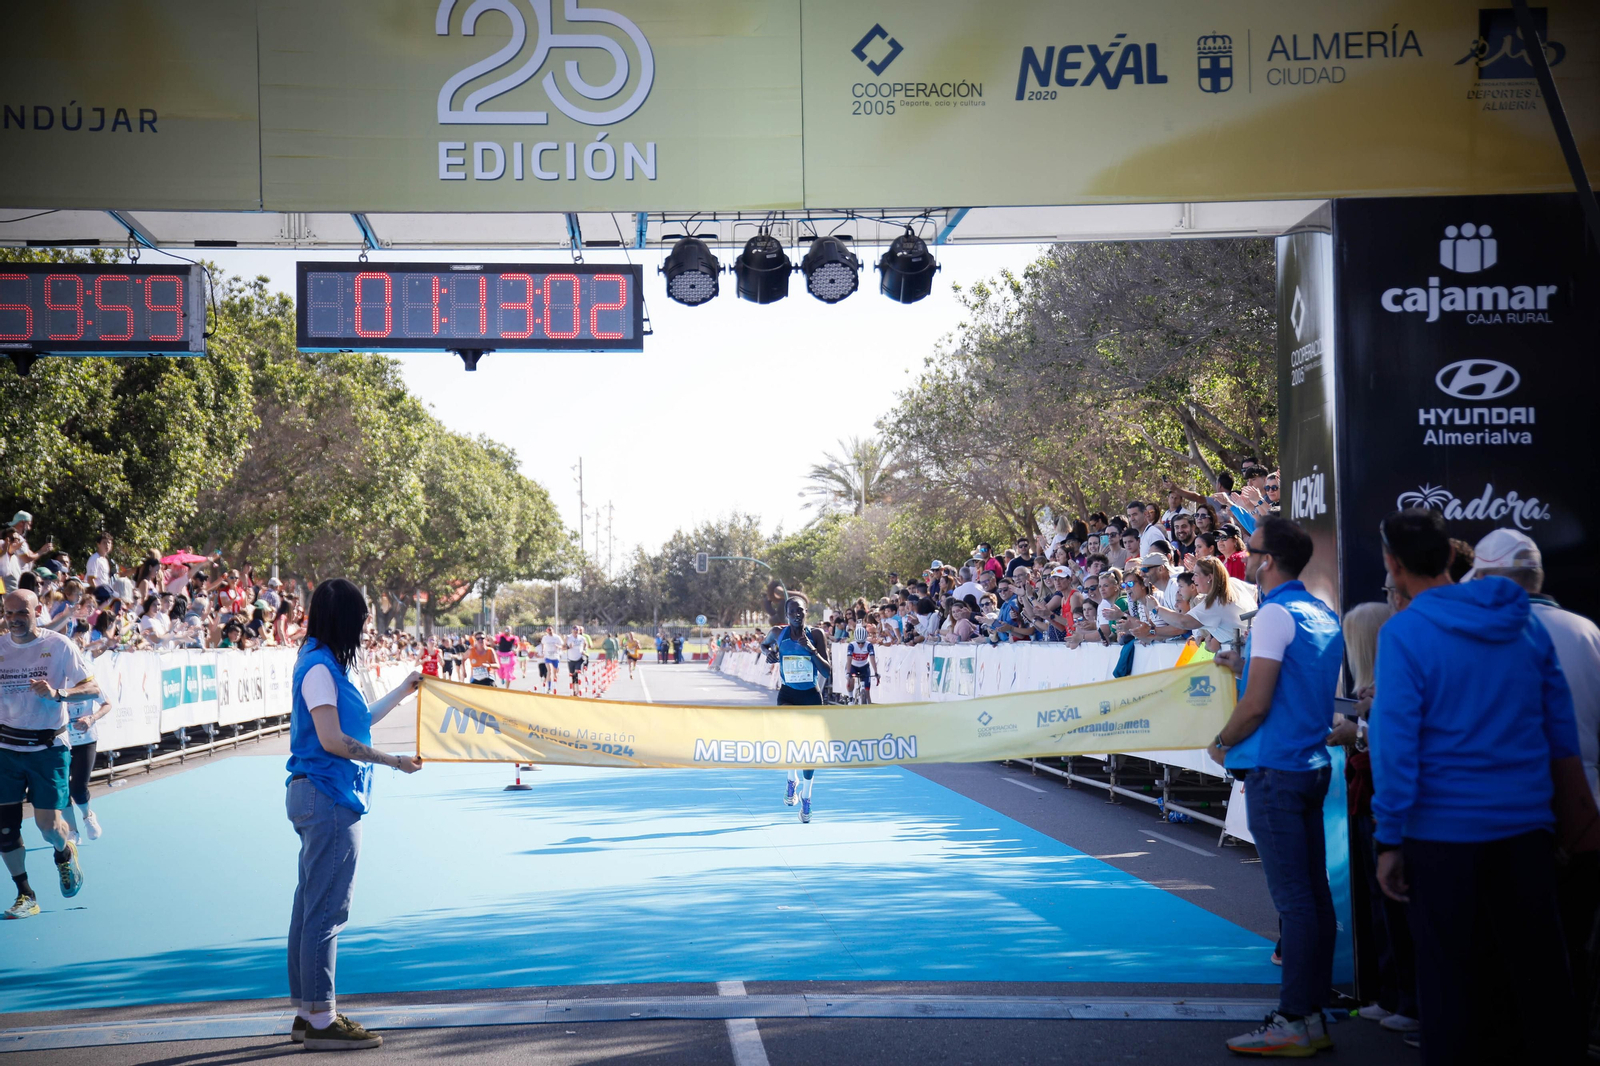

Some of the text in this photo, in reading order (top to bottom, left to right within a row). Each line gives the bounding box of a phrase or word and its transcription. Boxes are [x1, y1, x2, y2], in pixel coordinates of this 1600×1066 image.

[1267, 23, 1423, 62] ALMERÍA
[436, 0, 655, 125] 25
[1267, 66, 1346, 86] CIUDAD
[851, 79, 983, 98] COOPERACIÓN
[1027, 91, 1057, 100] 2020
[1467, 89, 1531, 99] DEPORTES
[852, 101, 896, 115] 2005
[437, 132, 657, 181] EDICIÓN
[354, 271, 627, 340] 01:13:02
[1381, 276, 1558, 322] cajamar
[1466, 313, 1553, 324] CAJA RURAL
[1418, 407, 1535, 425] HYUNDAI
[1423, 429, 1532, 445] Almerialva
[528, 723, 636, 743] Medio Maratón
[694, 733, 917, 763] MEDIO MARATÓN
